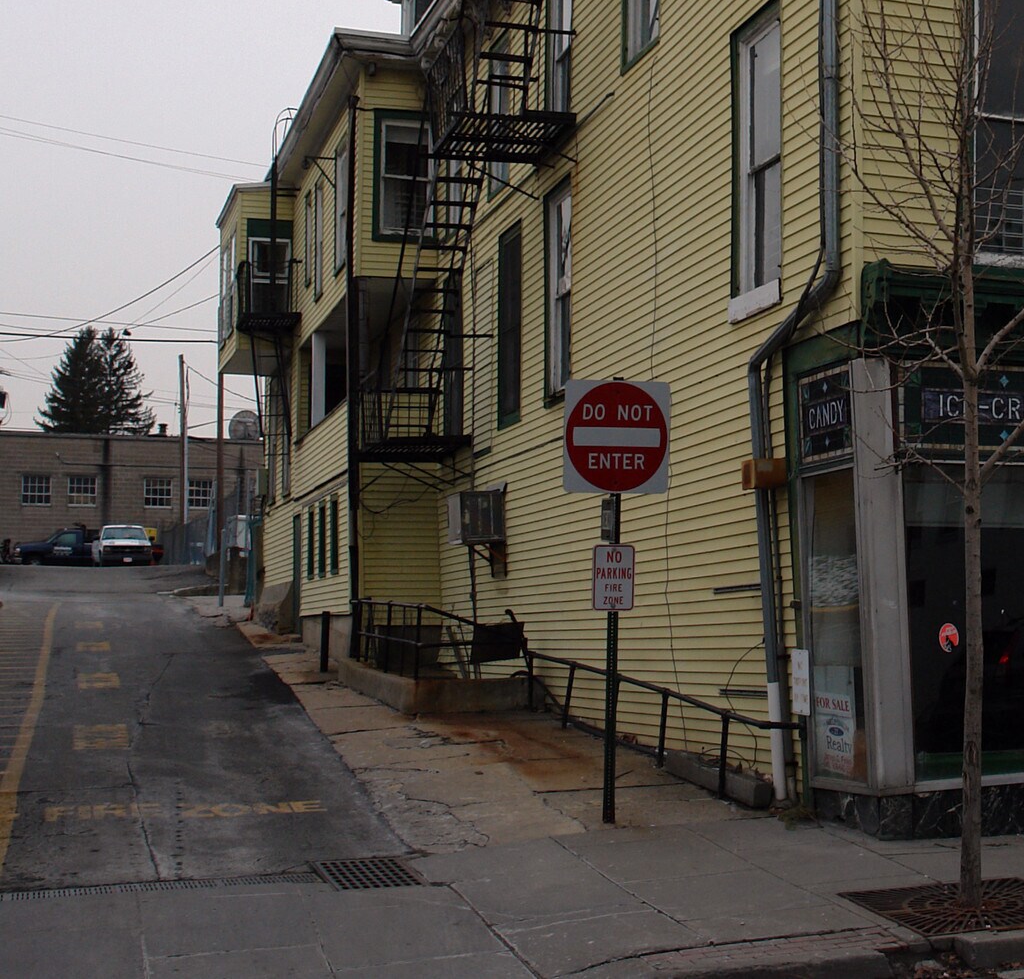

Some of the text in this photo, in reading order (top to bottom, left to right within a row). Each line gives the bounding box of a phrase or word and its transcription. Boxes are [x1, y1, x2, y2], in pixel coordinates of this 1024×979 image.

[582, 403, 653, 421] DO NOT
[808, 397, 846, 430] CANDY
[588, 453, 645, 470] ENTER
[607, 551, 622, 563] NO
[596, 567, 632, 580] PARKING
[604, 583, 623, 593] FIRE
[603, 596, 624, 605] ZONE
[816, 696, 831, 710] FOR
[831, 698, 850, 712] SALE
[45, 800, 327, 822] FIRE ZONE
